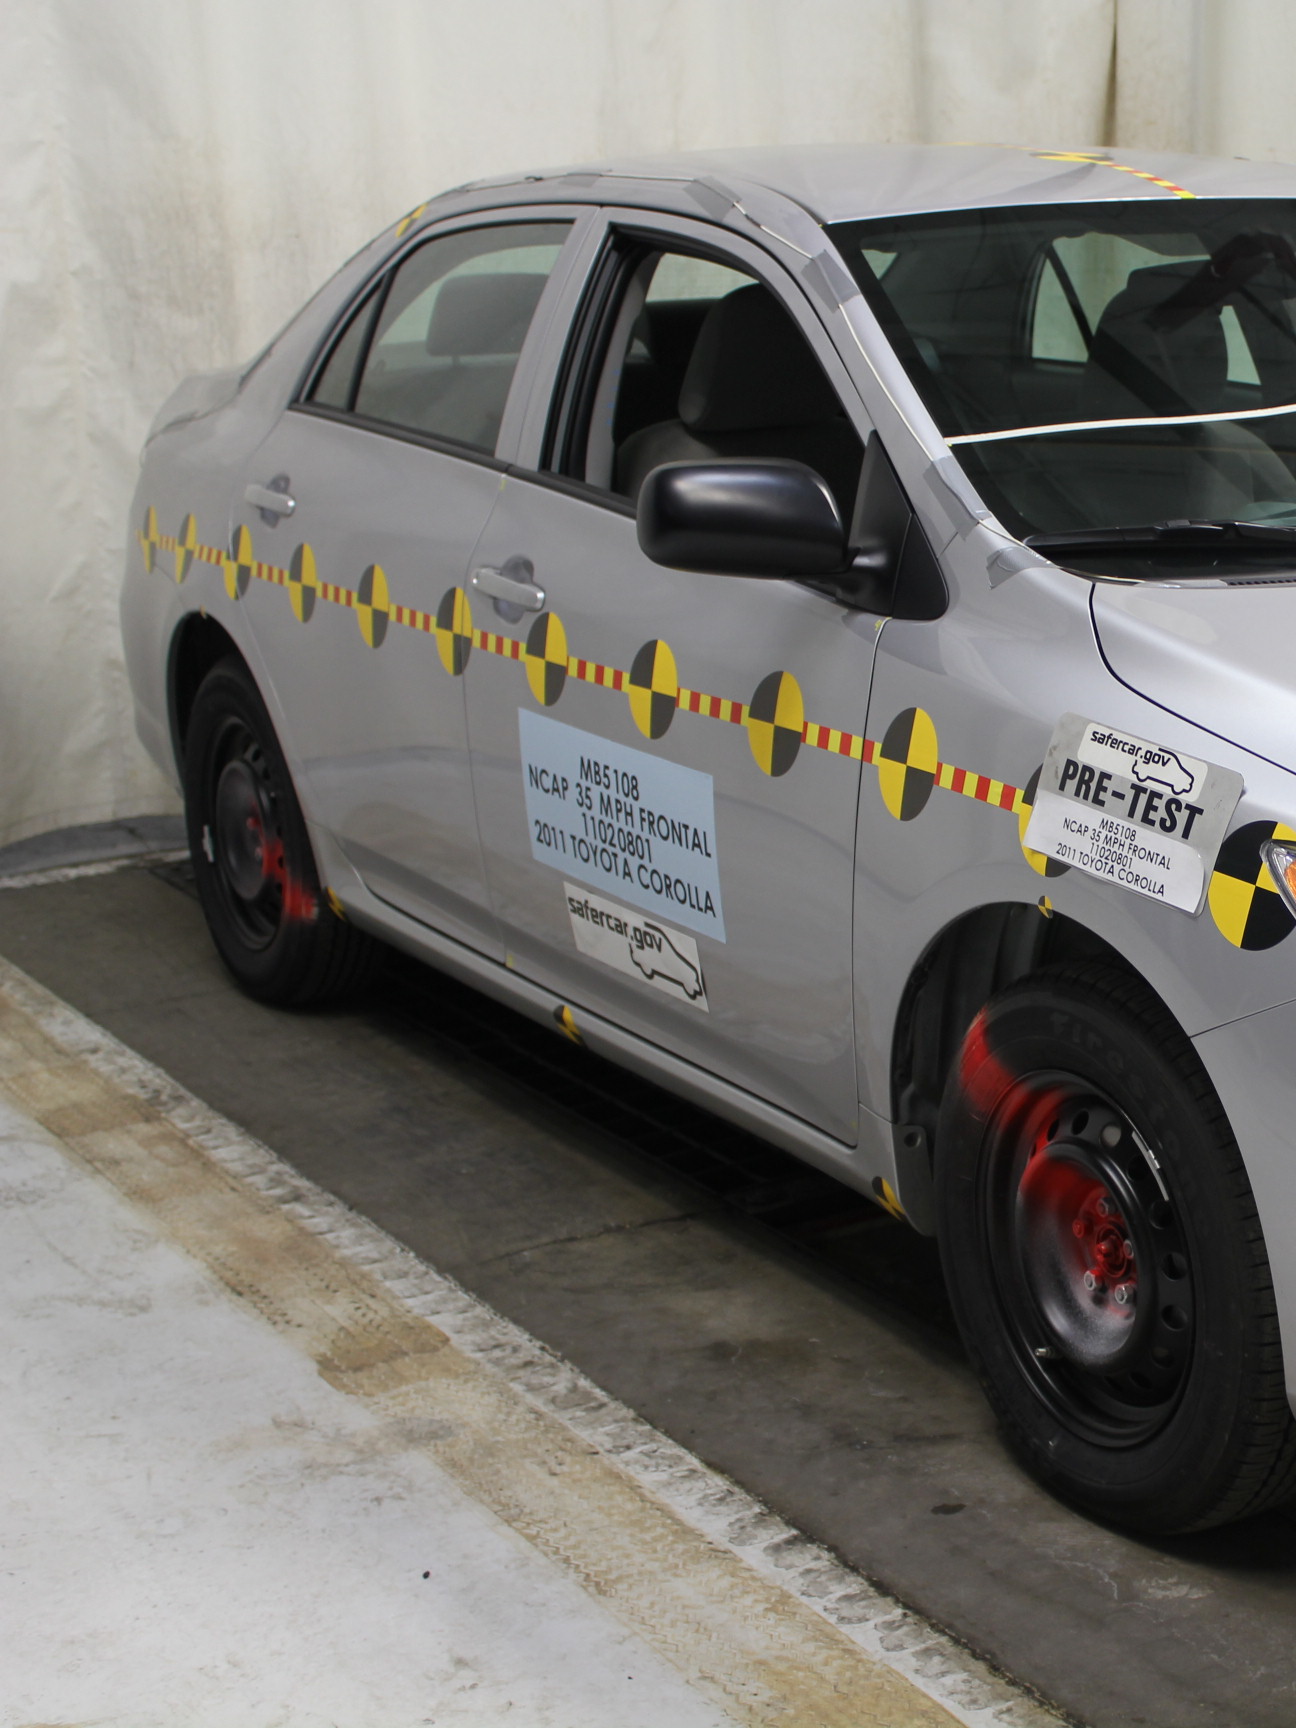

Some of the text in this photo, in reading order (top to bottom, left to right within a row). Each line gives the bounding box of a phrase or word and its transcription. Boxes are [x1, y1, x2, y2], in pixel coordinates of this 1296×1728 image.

[1090, 730, 1171, 768] safercar.gov
[579, 756, 640, 801] MB5108
[1058, 758, 1204, 840] PRE-TEST
[528, 763, 711, 858] NCAP 35 MPH FRONTAL
[1099, 817, 1137, 842] MB5108
[582, 812, 653, 863] 11020801
[1063, 817, 1171, 870] NCAP 35 MPH FRONTAL
[1090, 842, 1133, 870] 11020801
[534, 819, 716, 918] 2011 TOYOTA COROLLA
[1056, 842, 1165, 897] 2011 TOYOTA COROLLA
[567, 895, 662, 954] safercar.gov
